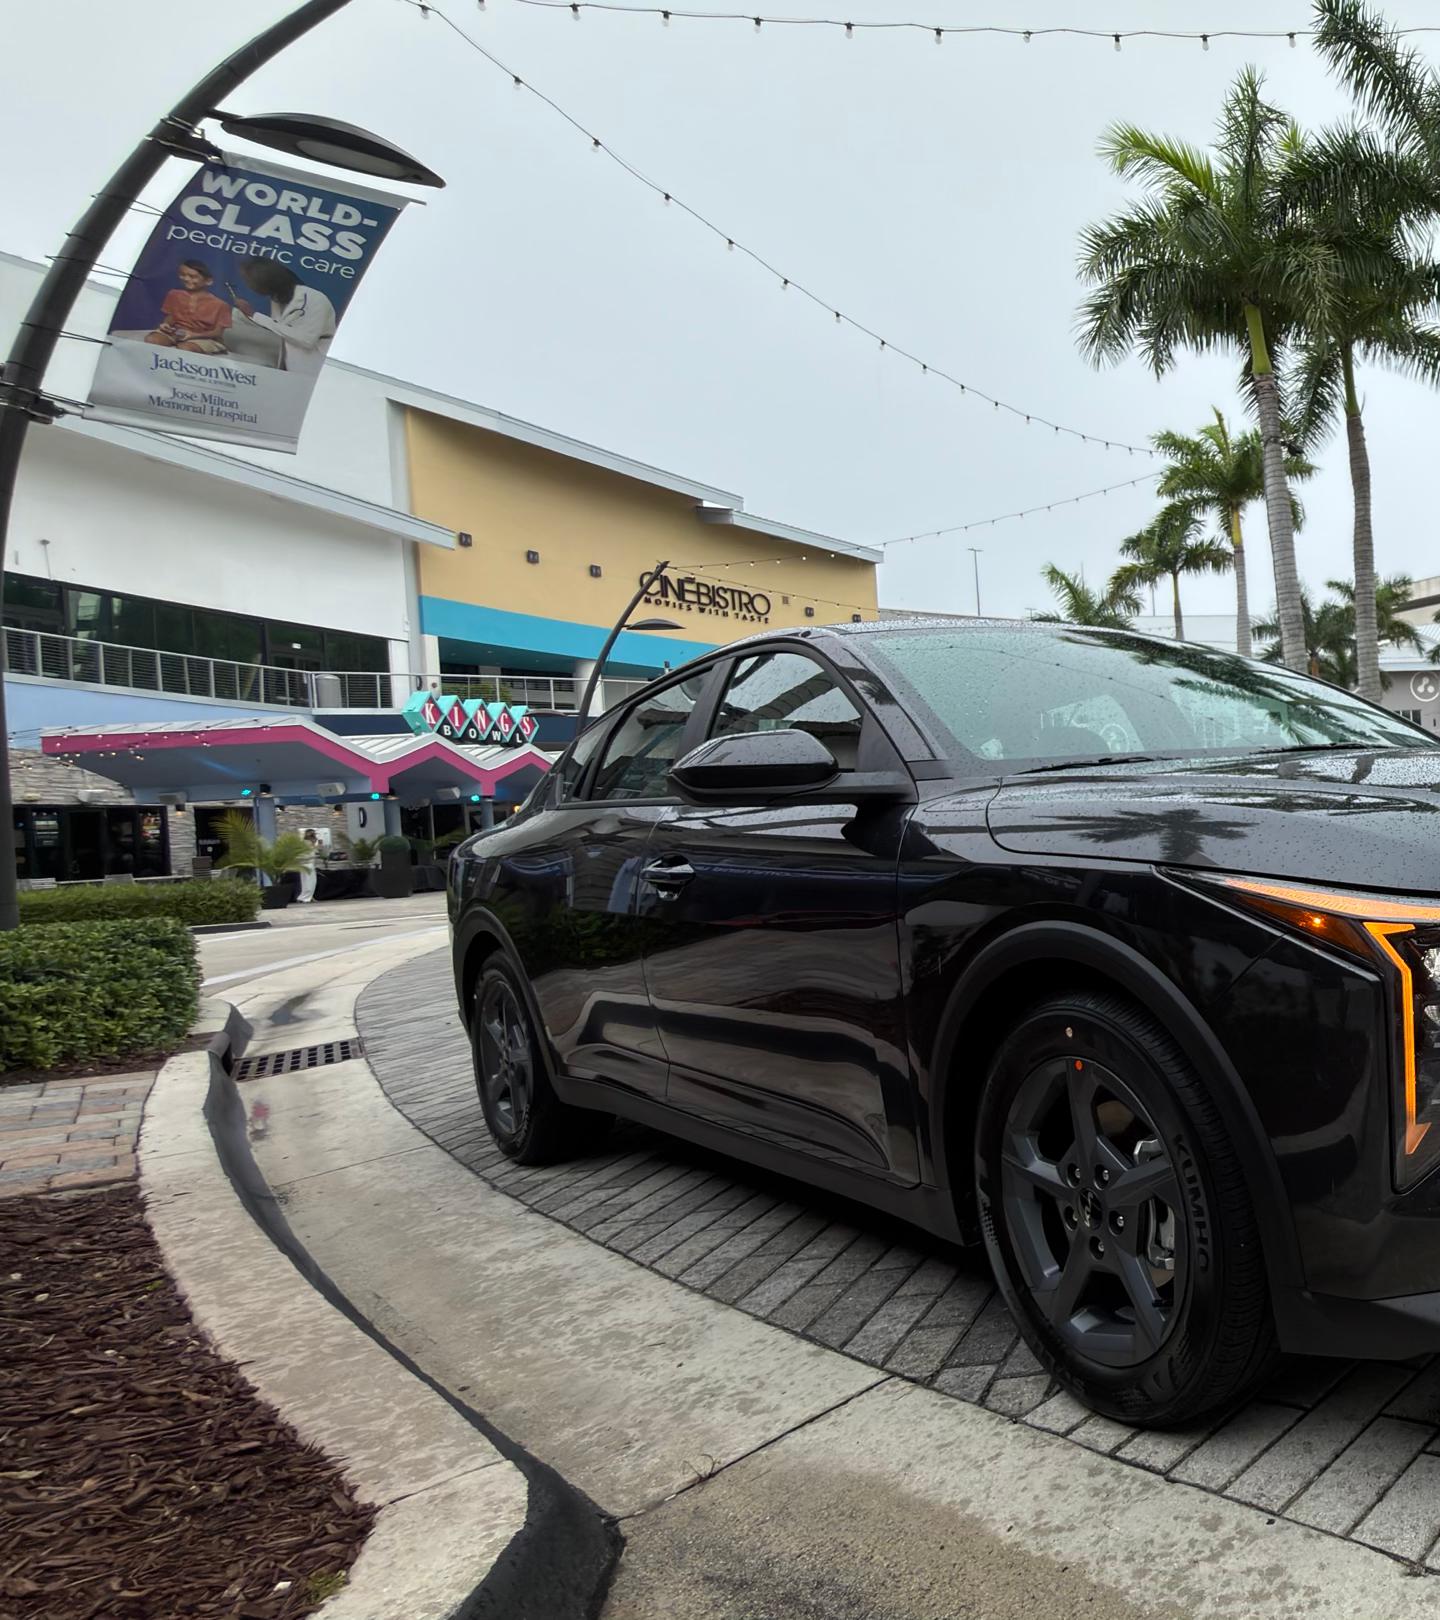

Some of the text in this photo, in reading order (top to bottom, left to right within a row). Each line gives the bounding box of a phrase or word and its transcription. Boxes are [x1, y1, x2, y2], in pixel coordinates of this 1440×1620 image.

[202, 170, 378, 228] WORLD-
[180, 195, 367, 260] CLASS
[166, 224, 356, 280] pediatric care
[150, 352, 219, 379] Jackson
[219, 366, 257, 386] West
[148, 394, 258, 425] Memorial Hospital
[200, 392, 239, 410] Milton
[643, 596, 770, 625] MOVIES WITH TASTE
[424, 702, 531, 736] KINGS
[443, 724, 523, 744] BOWL
[1173, 1133, 1210, 1273] KUMHO
